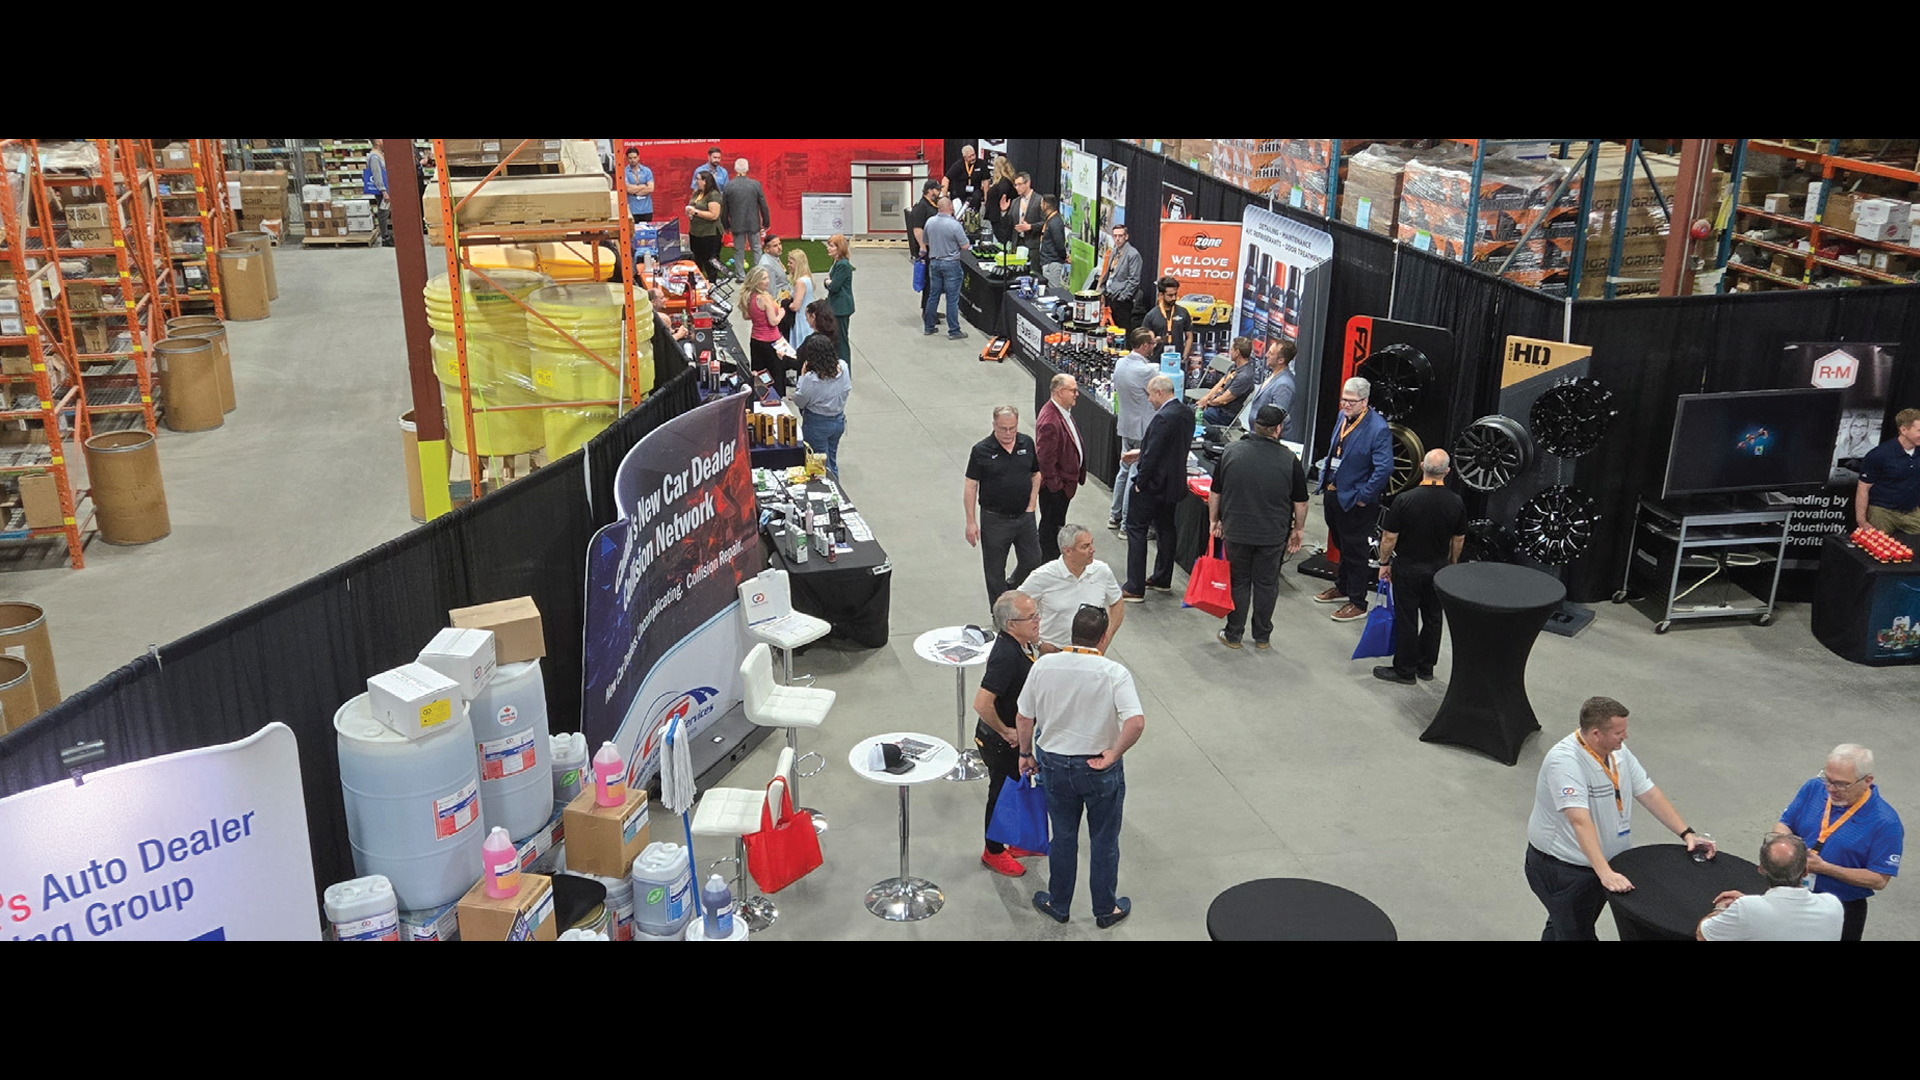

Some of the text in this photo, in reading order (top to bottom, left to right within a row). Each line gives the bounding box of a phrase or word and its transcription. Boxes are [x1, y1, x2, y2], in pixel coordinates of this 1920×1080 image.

[72, 232, 100, 240] XGC4
[1178, 235, 1222, 248] emzone
[1254, 230, 1282, 248] REFRIGERANTS
[1285, 243, 1297, 254] ODOR
[1258, 223, 1312, 249] DETAILING MAINTENANCE
[1171, 255, 1229, 266] WE LOVE
[1164, 267, 1235, 280] CARS TOO!
[1513, 343, 1551, 366] HD
[1819, 366, 1851, 378] R-M
[637, 438, 736, 532] New Car Dealer
[1833, 495, 1848, 508] by
[655, 492, 716, 556] Network
[1790, 510, 1846, 520] novation,
[1787, 522, 1847, 534] oductivity,
[686, 558, 718, 588] Collision
[719, 540, 744, 566] Repair.
[42, 856, 127, 911] Auto
[138, 810, 254, 873] Dealer
[86, 878, 194, 937] Group
